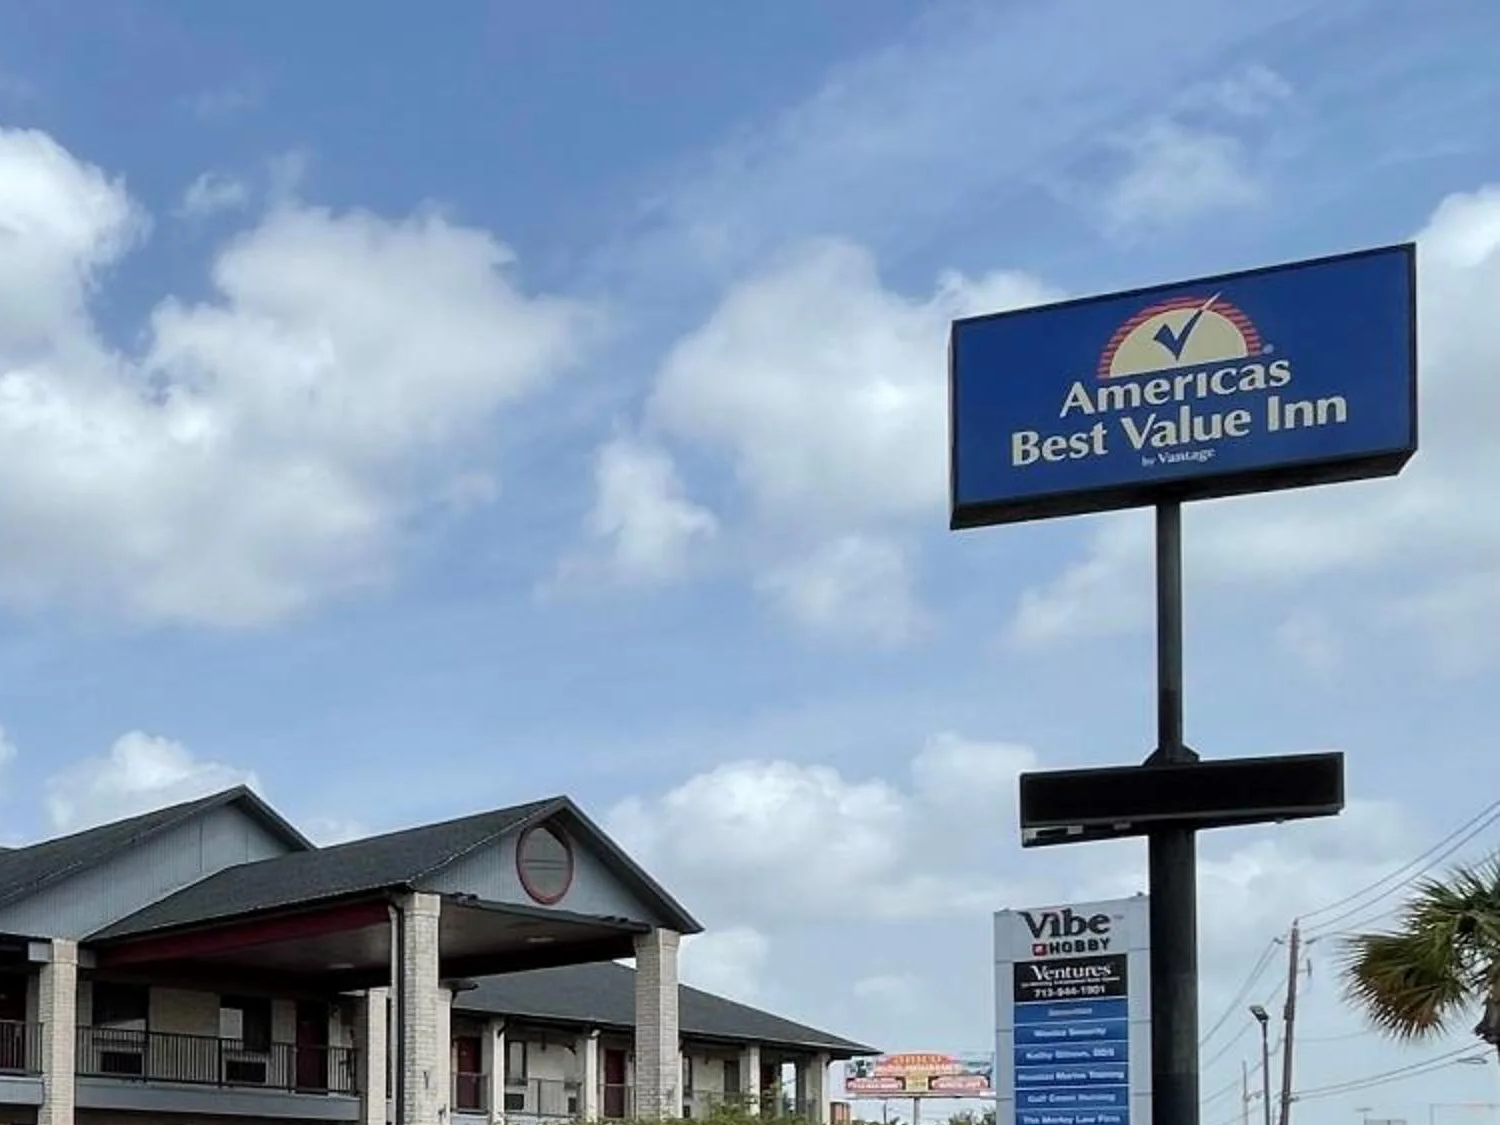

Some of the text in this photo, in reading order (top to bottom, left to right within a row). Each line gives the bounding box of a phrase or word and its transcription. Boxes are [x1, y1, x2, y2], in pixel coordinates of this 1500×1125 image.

[1059, 359, 1291, 419] Americas
[1011, 394, 1348, 467] Best Value Inn
[1157, 448, 1216, 464] Vantage
[1017, 907, 1111, 939] Vibe
[1049, 937, 1111, 955] HOBBY
[1029, 963, 1112, 981] Ventures
